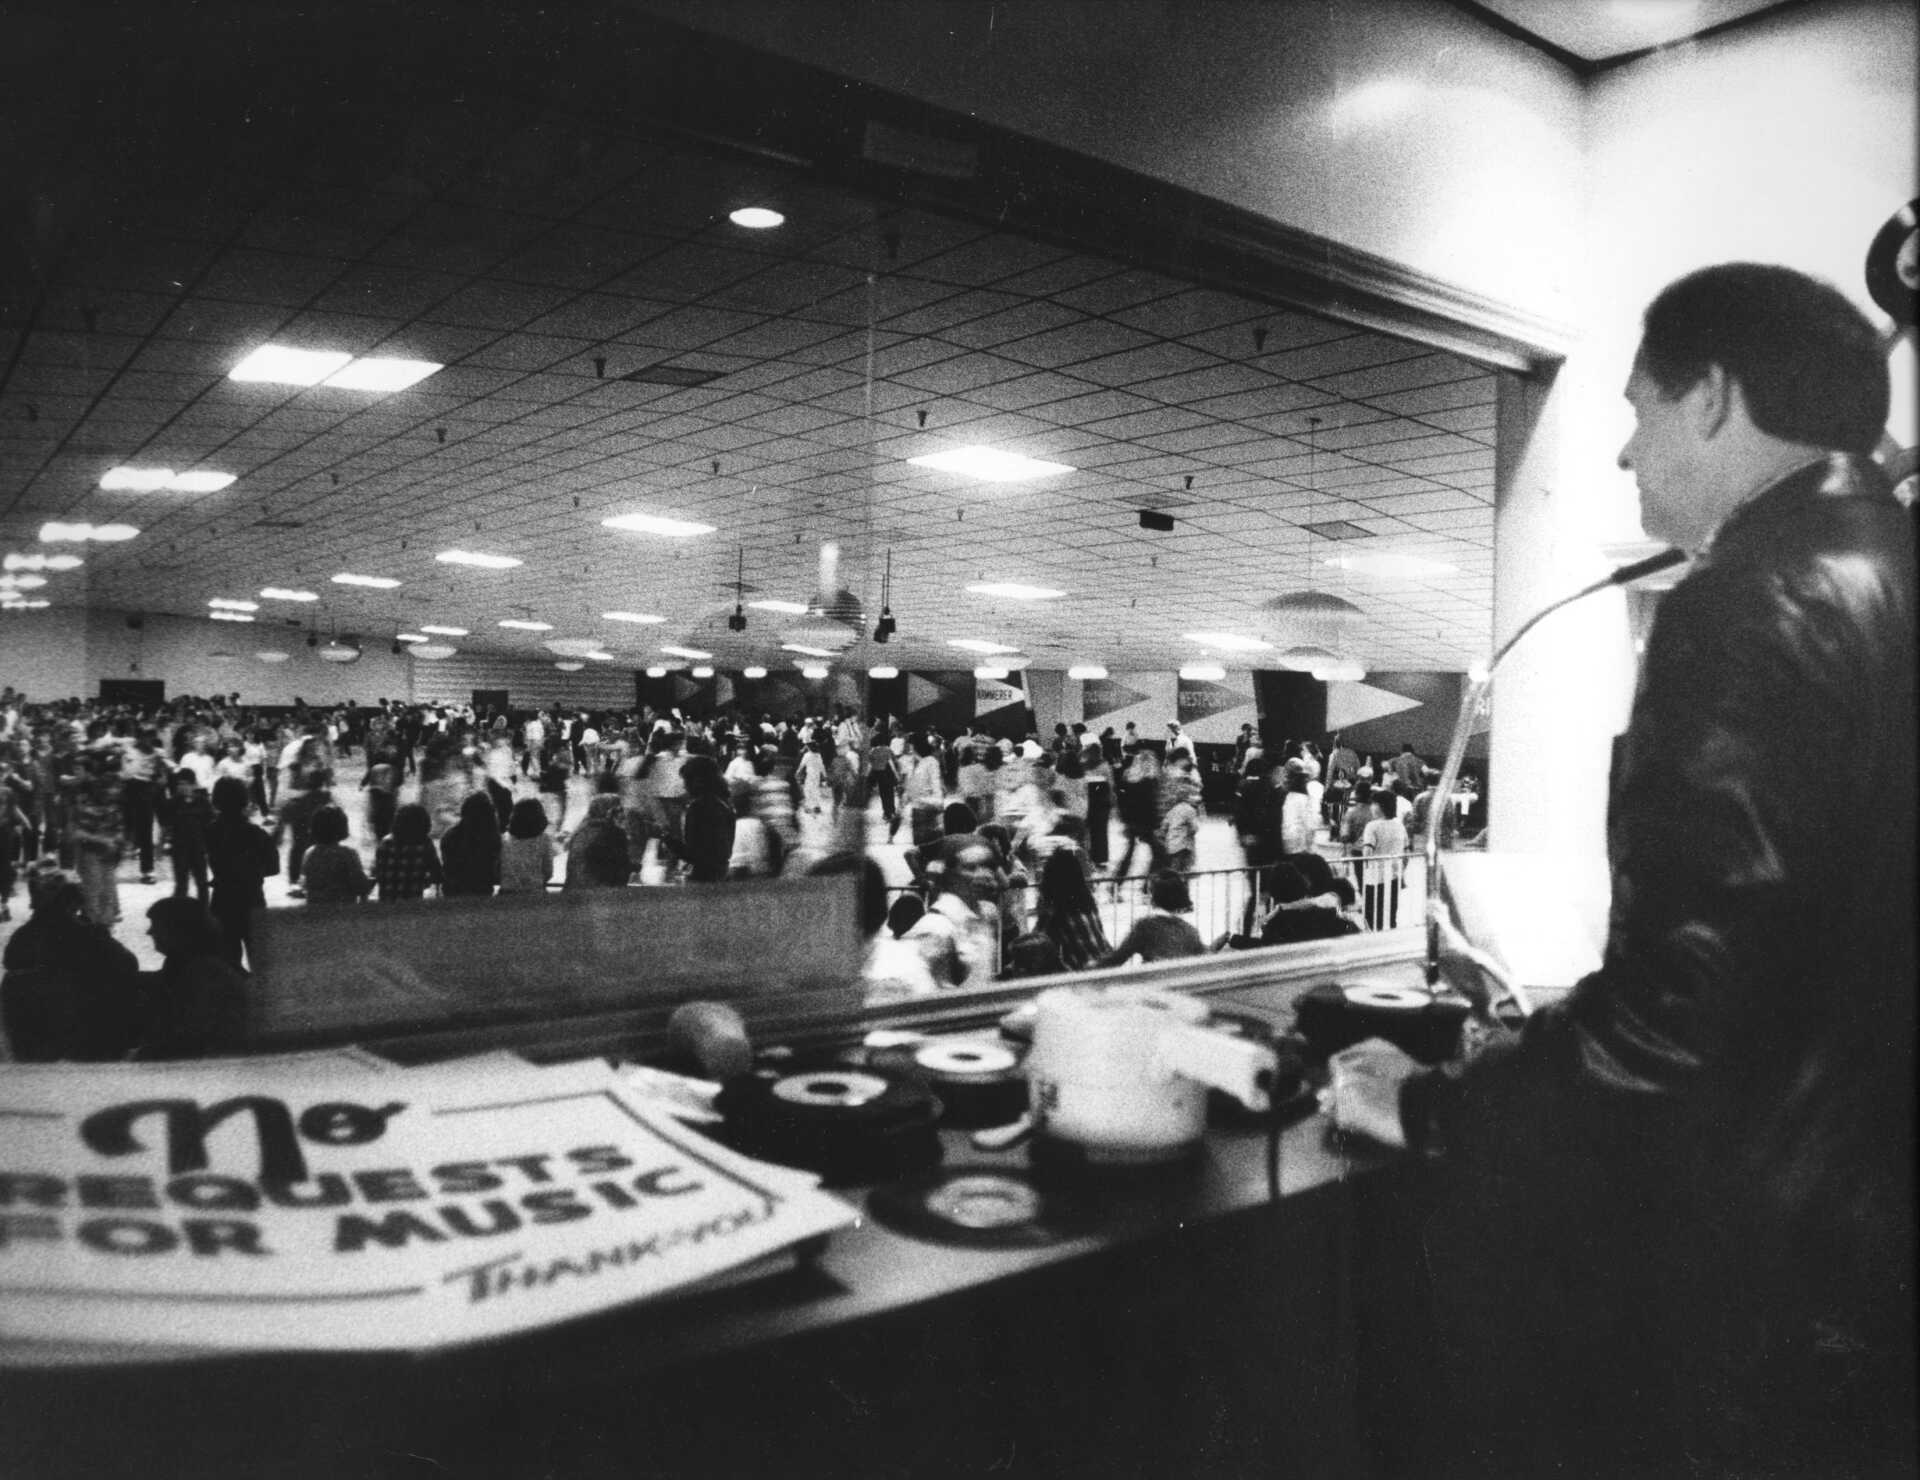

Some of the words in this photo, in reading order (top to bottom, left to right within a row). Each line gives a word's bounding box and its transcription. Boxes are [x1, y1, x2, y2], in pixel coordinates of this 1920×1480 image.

[0, 1144, 635, 1211] REQUESTS
[0, 1213, 273, 1257] FOR
[333, 1165, 703, 1254] MUSIC
